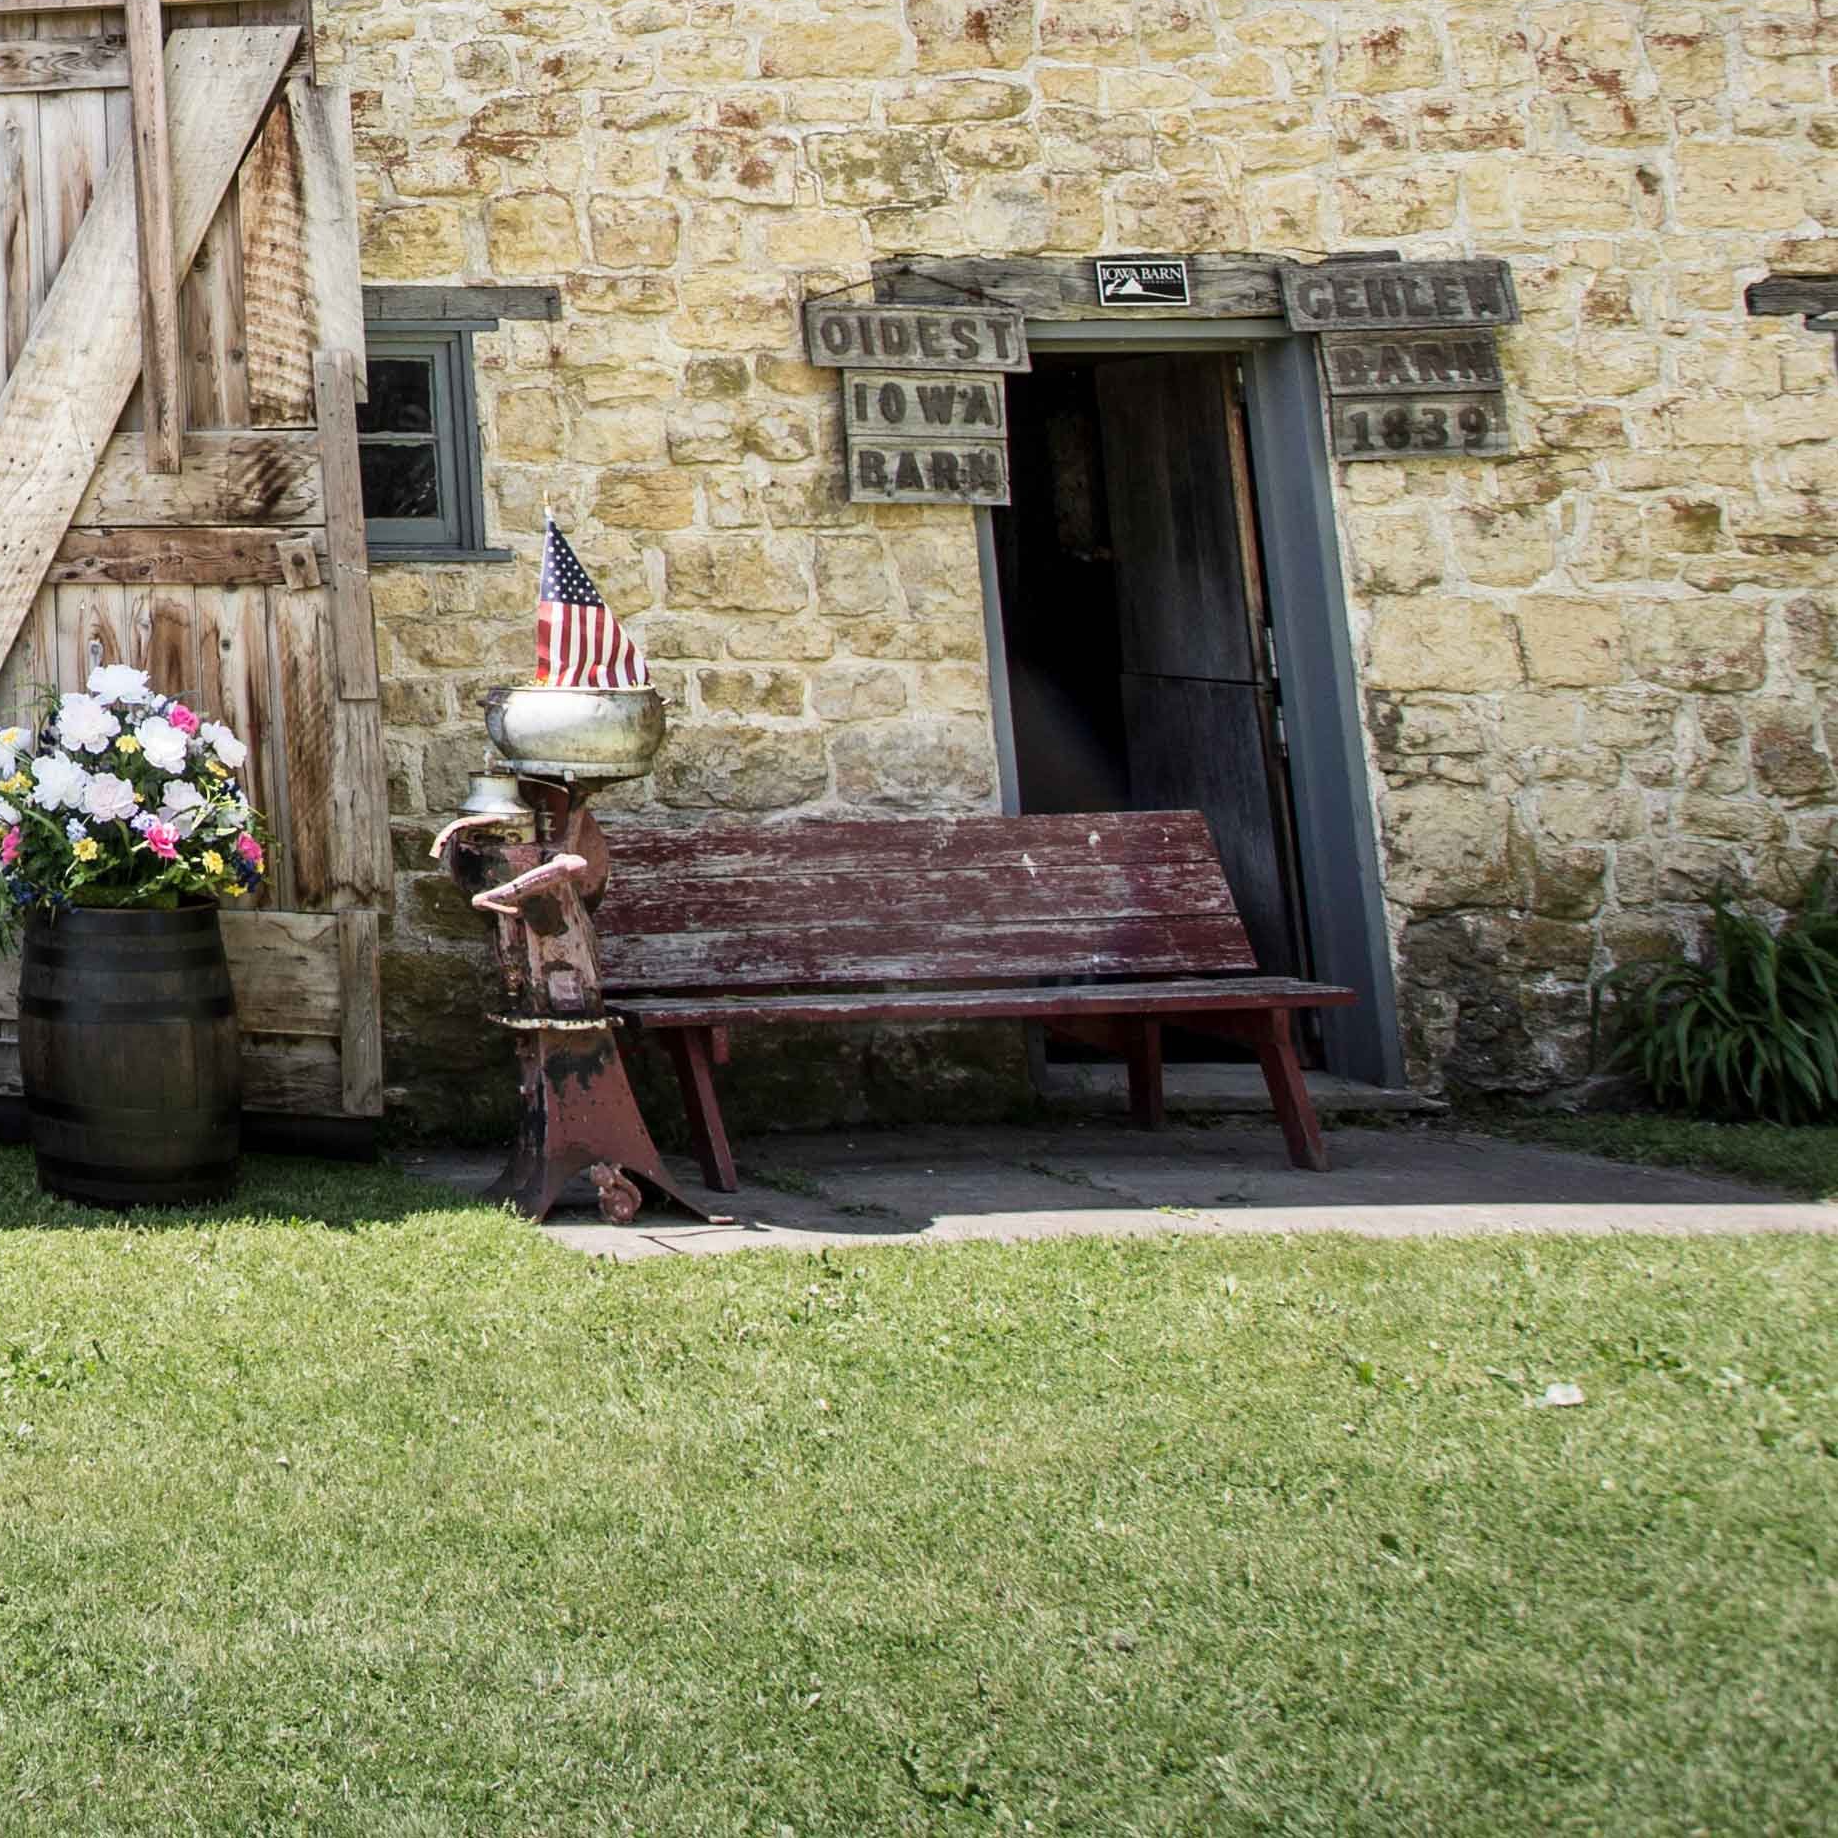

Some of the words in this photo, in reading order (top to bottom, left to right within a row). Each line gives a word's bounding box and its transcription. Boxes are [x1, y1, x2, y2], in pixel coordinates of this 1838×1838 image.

[1101, 267, 1140, 281] IOWA
[1140, 266, 1182, 280] BARN
[1298, 275, 1504, 320] GEHLEN
[1331, 340, 1499, 387] BARN
[853, 381, 996, 426] IOWA
[1348, 405, 1489, 452] 1839
[858, 448, 999, 492] BARN
